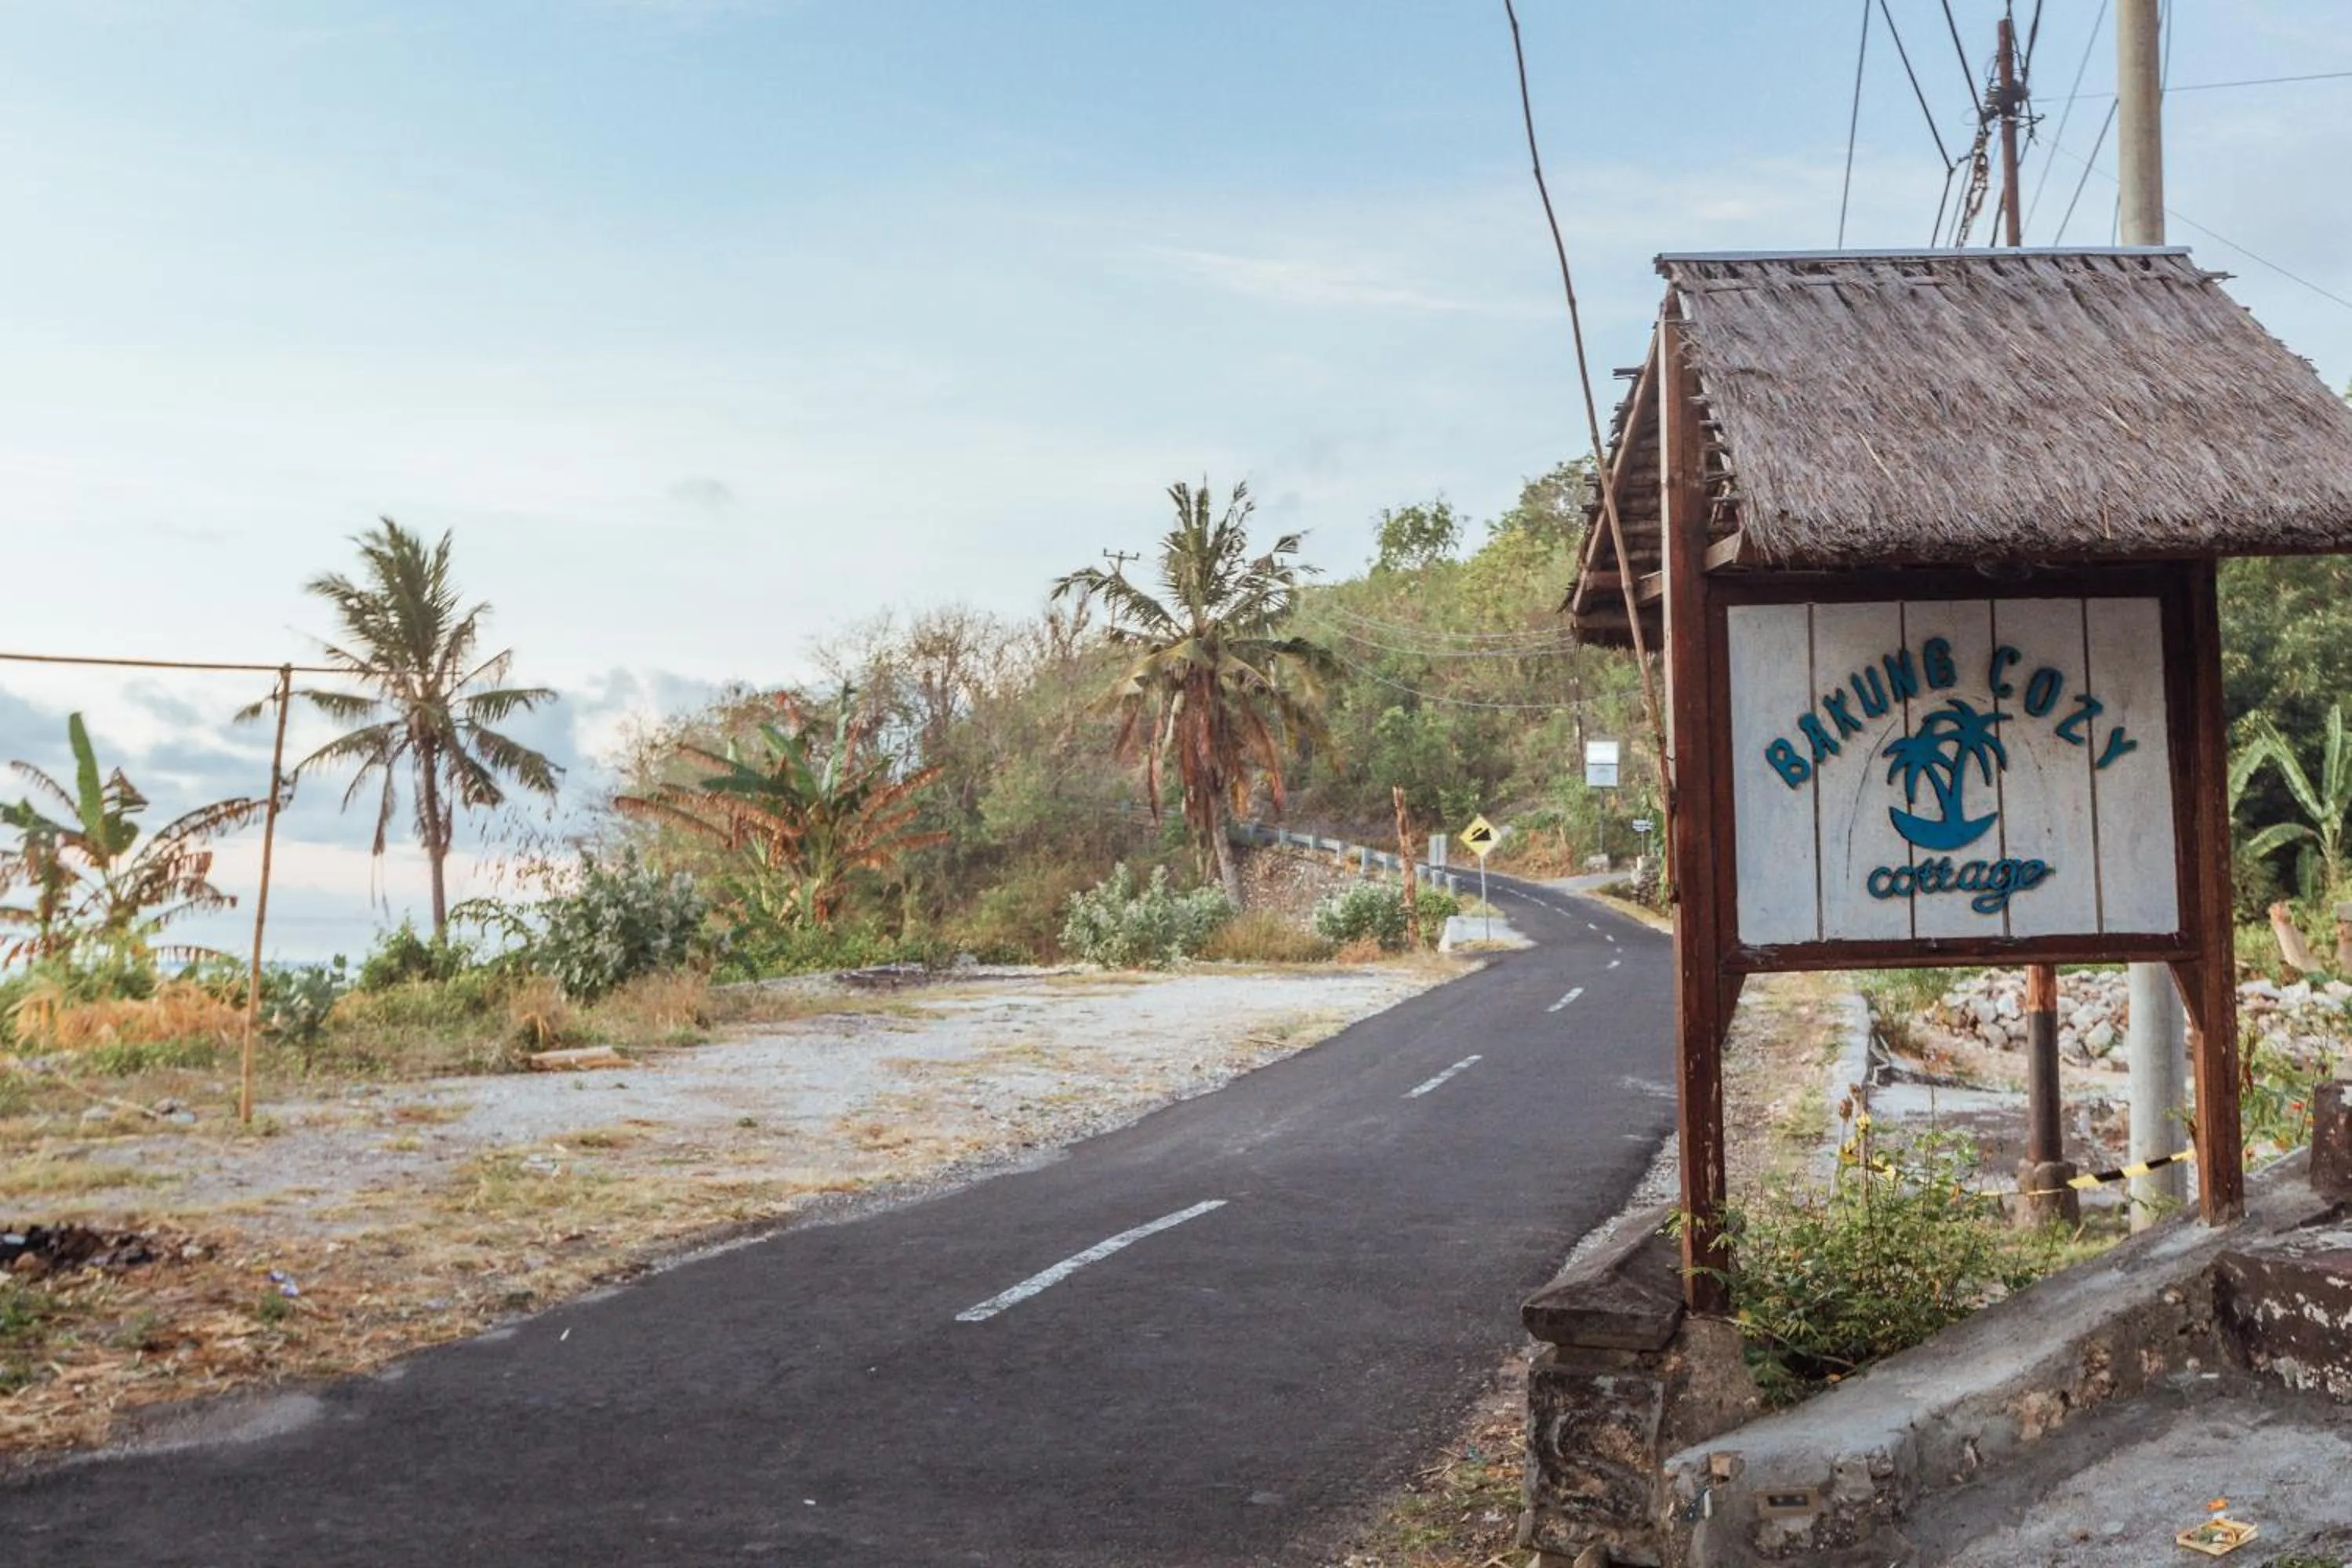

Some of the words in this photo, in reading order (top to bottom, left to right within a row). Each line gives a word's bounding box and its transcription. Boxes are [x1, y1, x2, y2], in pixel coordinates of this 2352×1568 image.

[1765, 637, 1958, 789] BAKUNG
[1990, 645, 2137, 769] COZY
[1867, 857, 2055, 913] cottage
